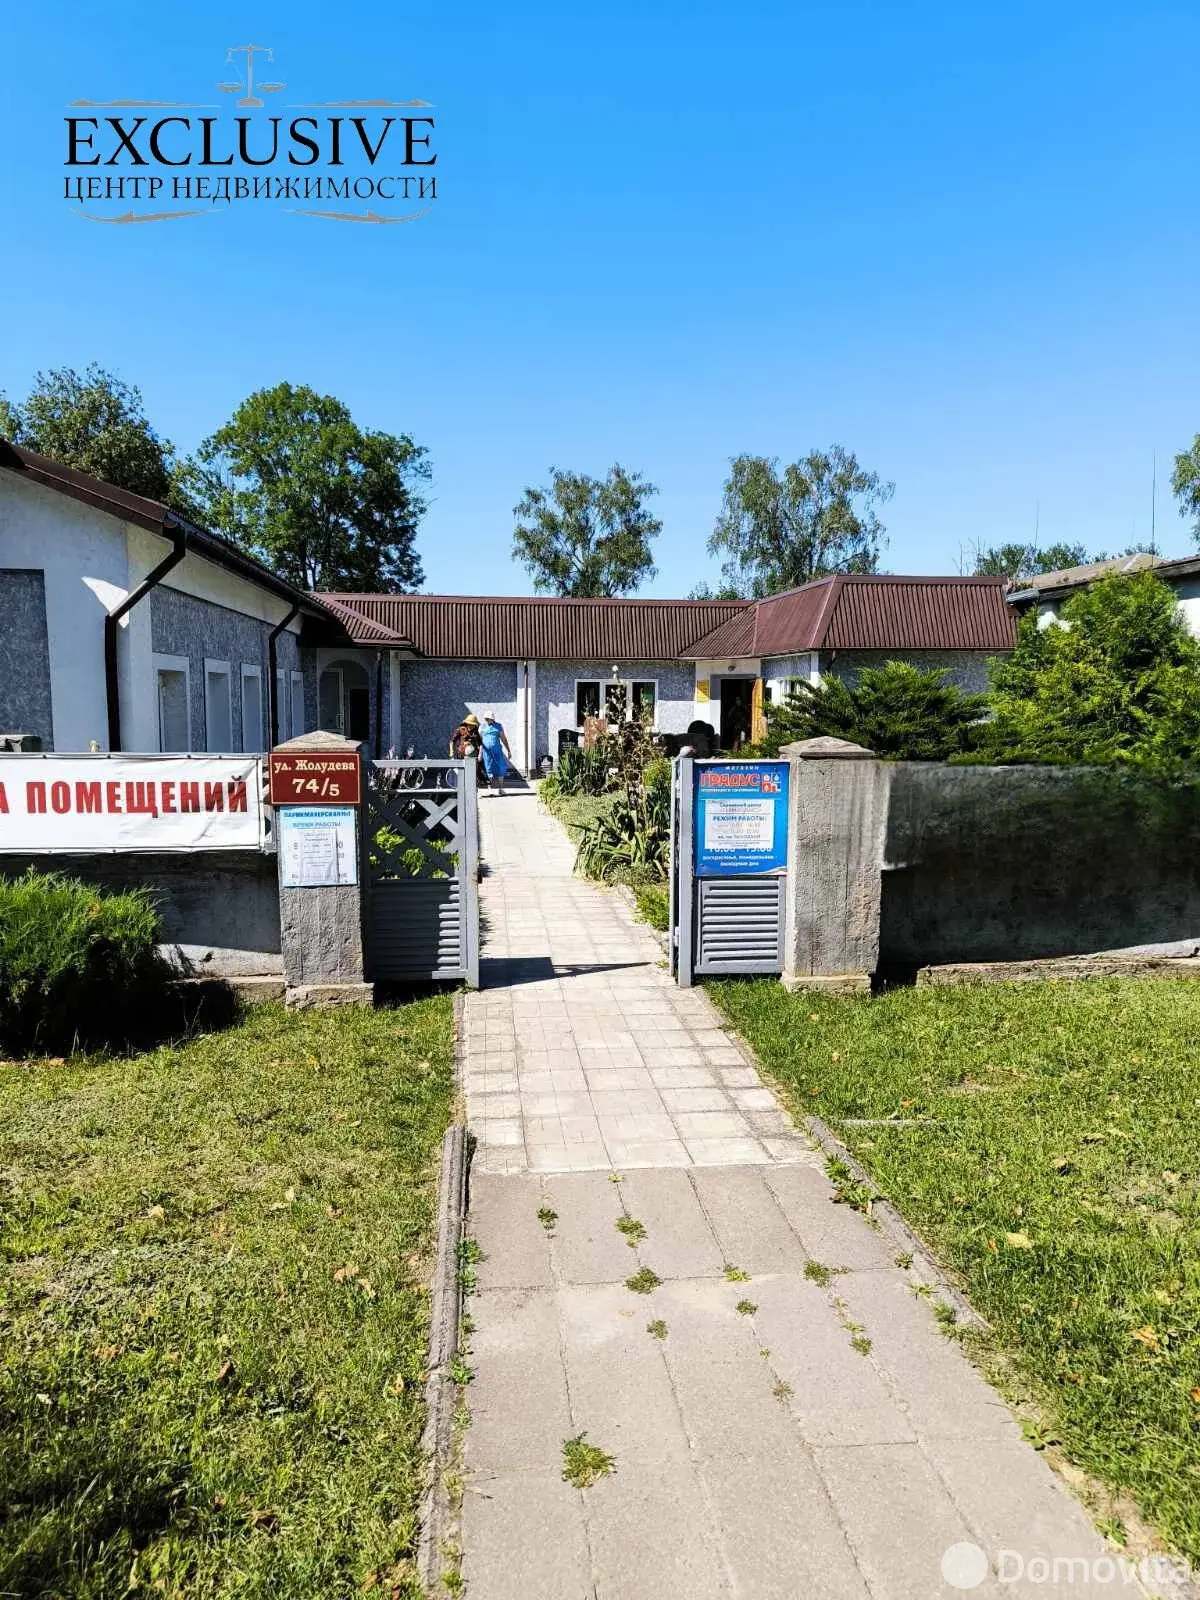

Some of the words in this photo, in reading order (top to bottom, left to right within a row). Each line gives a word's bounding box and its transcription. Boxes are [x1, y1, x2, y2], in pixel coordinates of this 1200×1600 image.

[274, 762, 292, 774] ул.
[295, 759, 355, 773] Жолудева
[292, 777, 340, 797] 74/5
[701, 773, 760, 786] ГРАДУС
[26, 775, 248, 818] ПОМЕЩЕНИЙ
